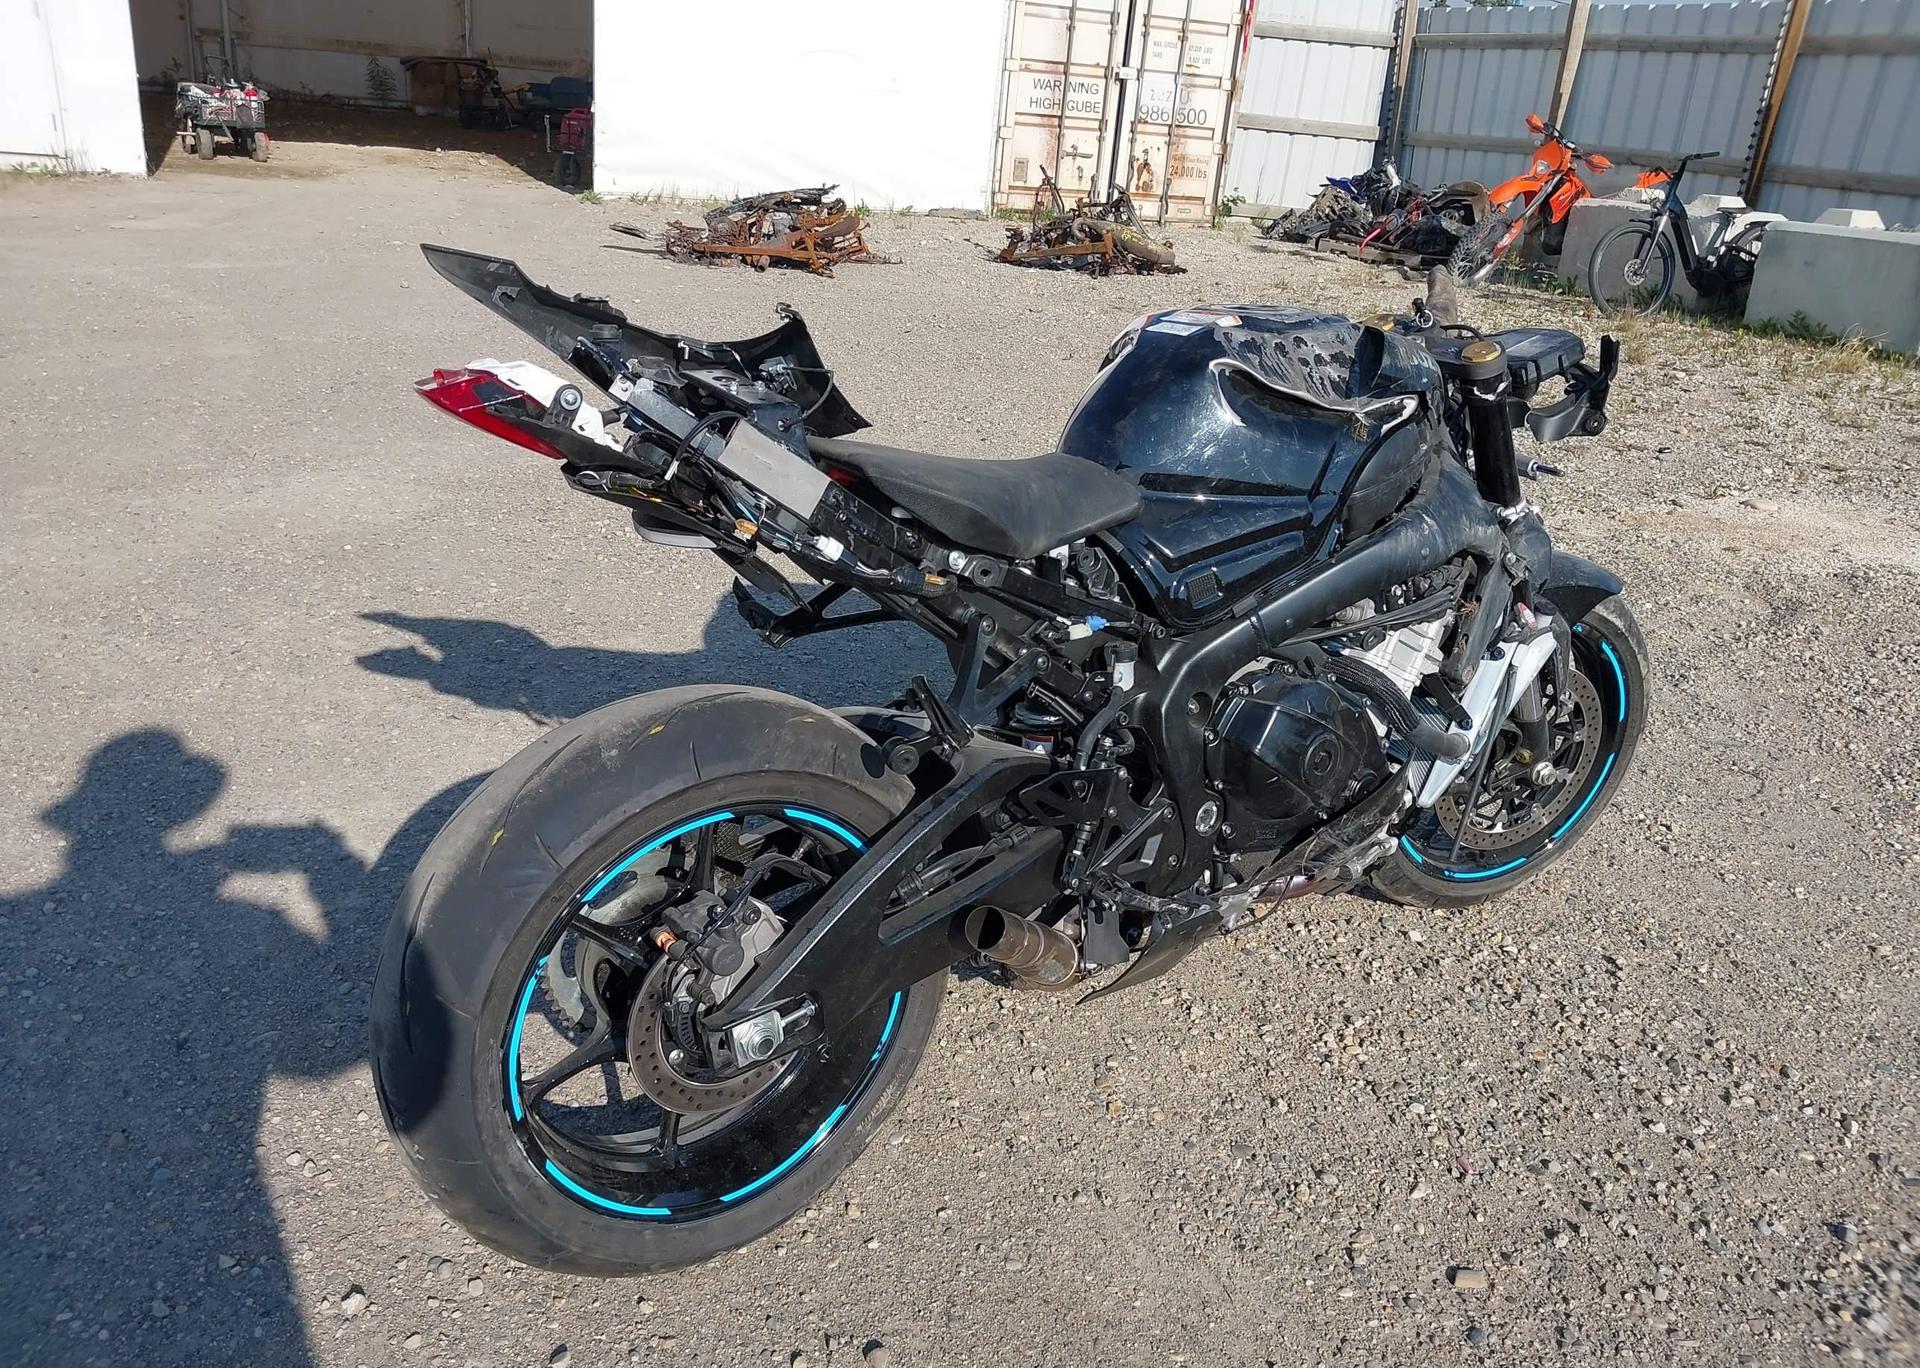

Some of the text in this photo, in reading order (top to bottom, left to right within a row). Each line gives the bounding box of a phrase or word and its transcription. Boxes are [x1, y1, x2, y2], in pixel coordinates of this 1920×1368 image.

[1033, 78, 1099, 95] WARNING
[1029, 97, 1061, 111] HIGH
[1195, 166, 1208, 179] lbs
